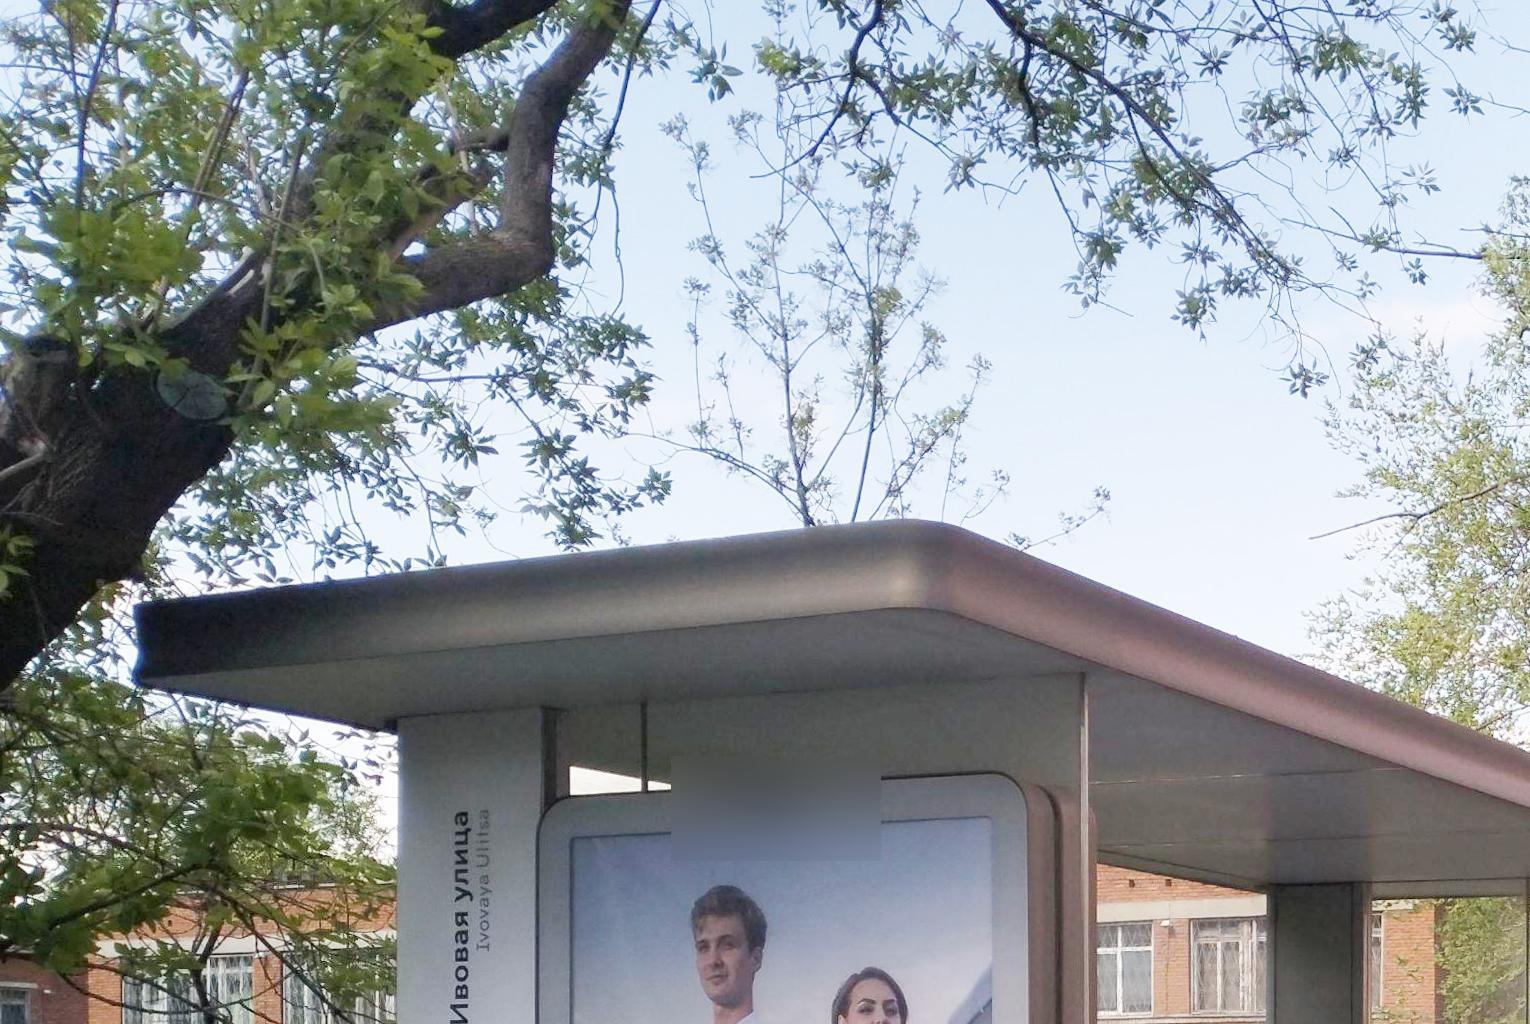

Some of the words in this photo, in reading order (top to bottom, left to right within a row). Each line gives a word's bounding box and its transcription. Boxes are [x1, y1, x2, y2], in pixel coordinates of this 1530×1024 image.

[454, 810, 473, 903] улица
[476, 809, 490, 868] Ulitsa
[476, 874, 493, 952] Ivovaya
